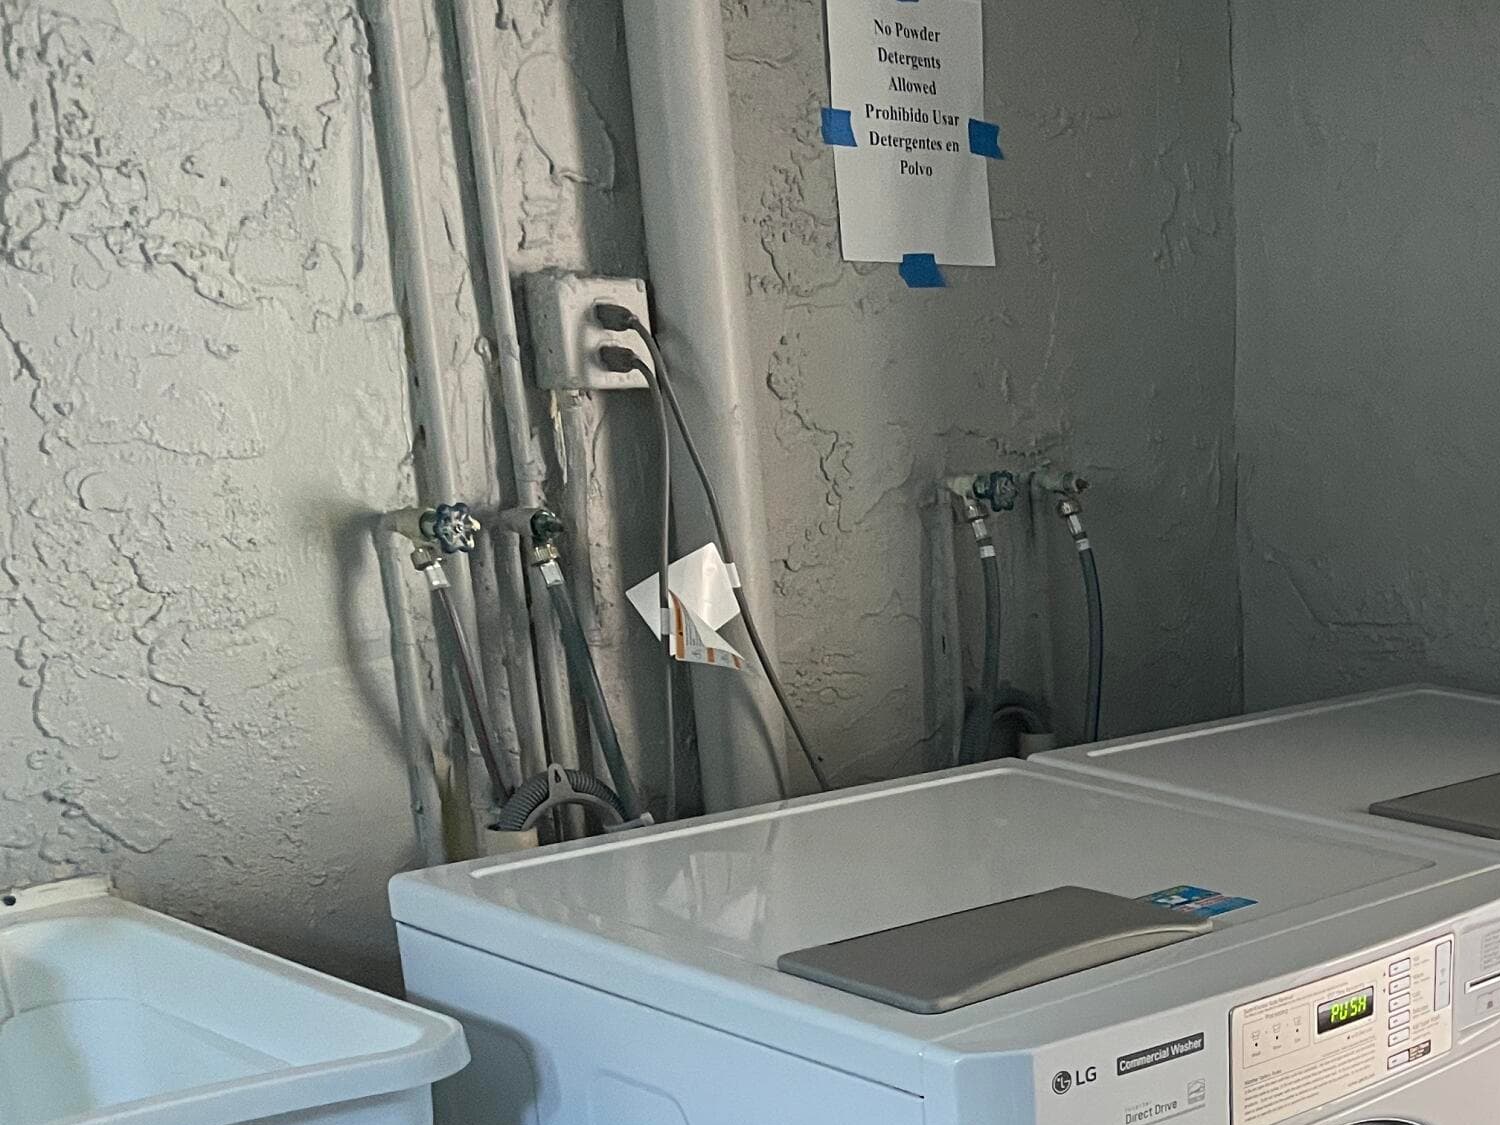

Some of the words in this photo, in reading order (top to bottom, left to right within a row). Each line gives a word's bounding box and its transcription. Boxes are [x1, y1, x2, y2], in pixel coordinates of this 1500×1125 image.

[874, 18, 892, 36] No
[895, 22, 941, 42] Powder
[878, 46, 941, 70] Detergents
[888, 76, 937, 95] Allowed
[865, 103, 929, 124] Prohibido
[933, 109, 960, 126] Usar
[869, 130, 942, 153] Detergentes
[946, 140, 960, 152] en
[900, 159, 933, 177] Polvo
[1330, 994, 1367, 1024] PUSH
[1119, 1047, 1170, 1072] Commercial
[1170, 1038, 1202, 1056] Washer
[1076, 1066, 1097, 1086] LG
[1125, 1107, 1153, 1125] Direct
[1154, 1100, 1178, 1115] Drive
